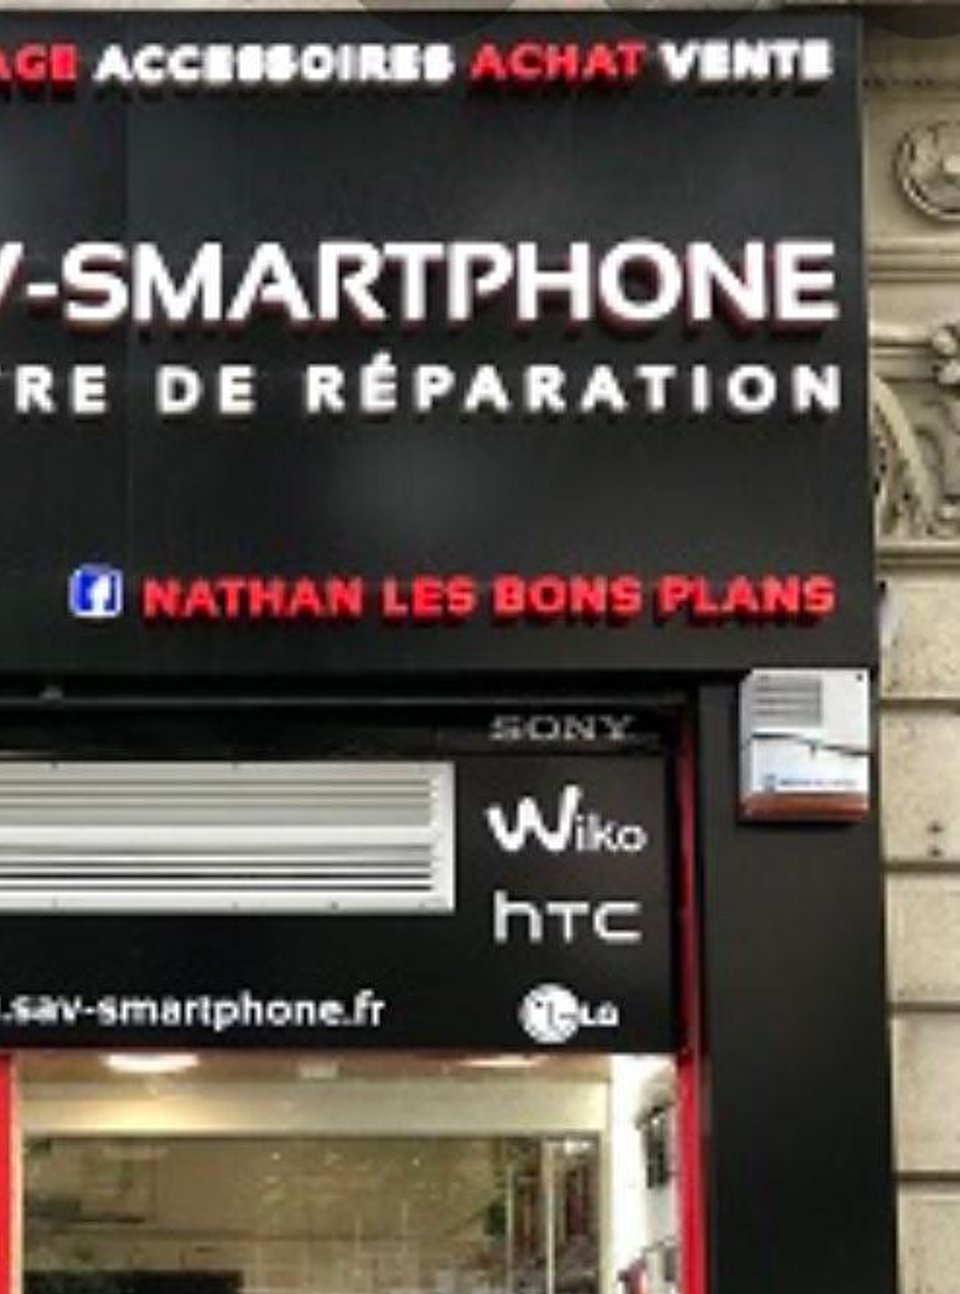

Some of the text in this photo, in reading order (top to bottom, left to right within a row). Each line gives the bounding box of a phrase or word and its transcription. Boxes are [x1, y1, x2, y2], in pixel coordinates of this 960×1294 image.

[93, 43, 455, 83] ACCESSOIRES
[472, 41, 646, 79] ACHAT
[658, 39, 833, 80] VENTE
[157, 365, 255, 413] DE
[305, 353, 841, 413] RÉPARATION
[143, 577, 363, 616] NATHAN
[383, 576, 476, 615] LES
[492, 576, 642, 615] BONS
[657, 575, 835, 614] PLANS
[490, 715, 634, 740] SONY
